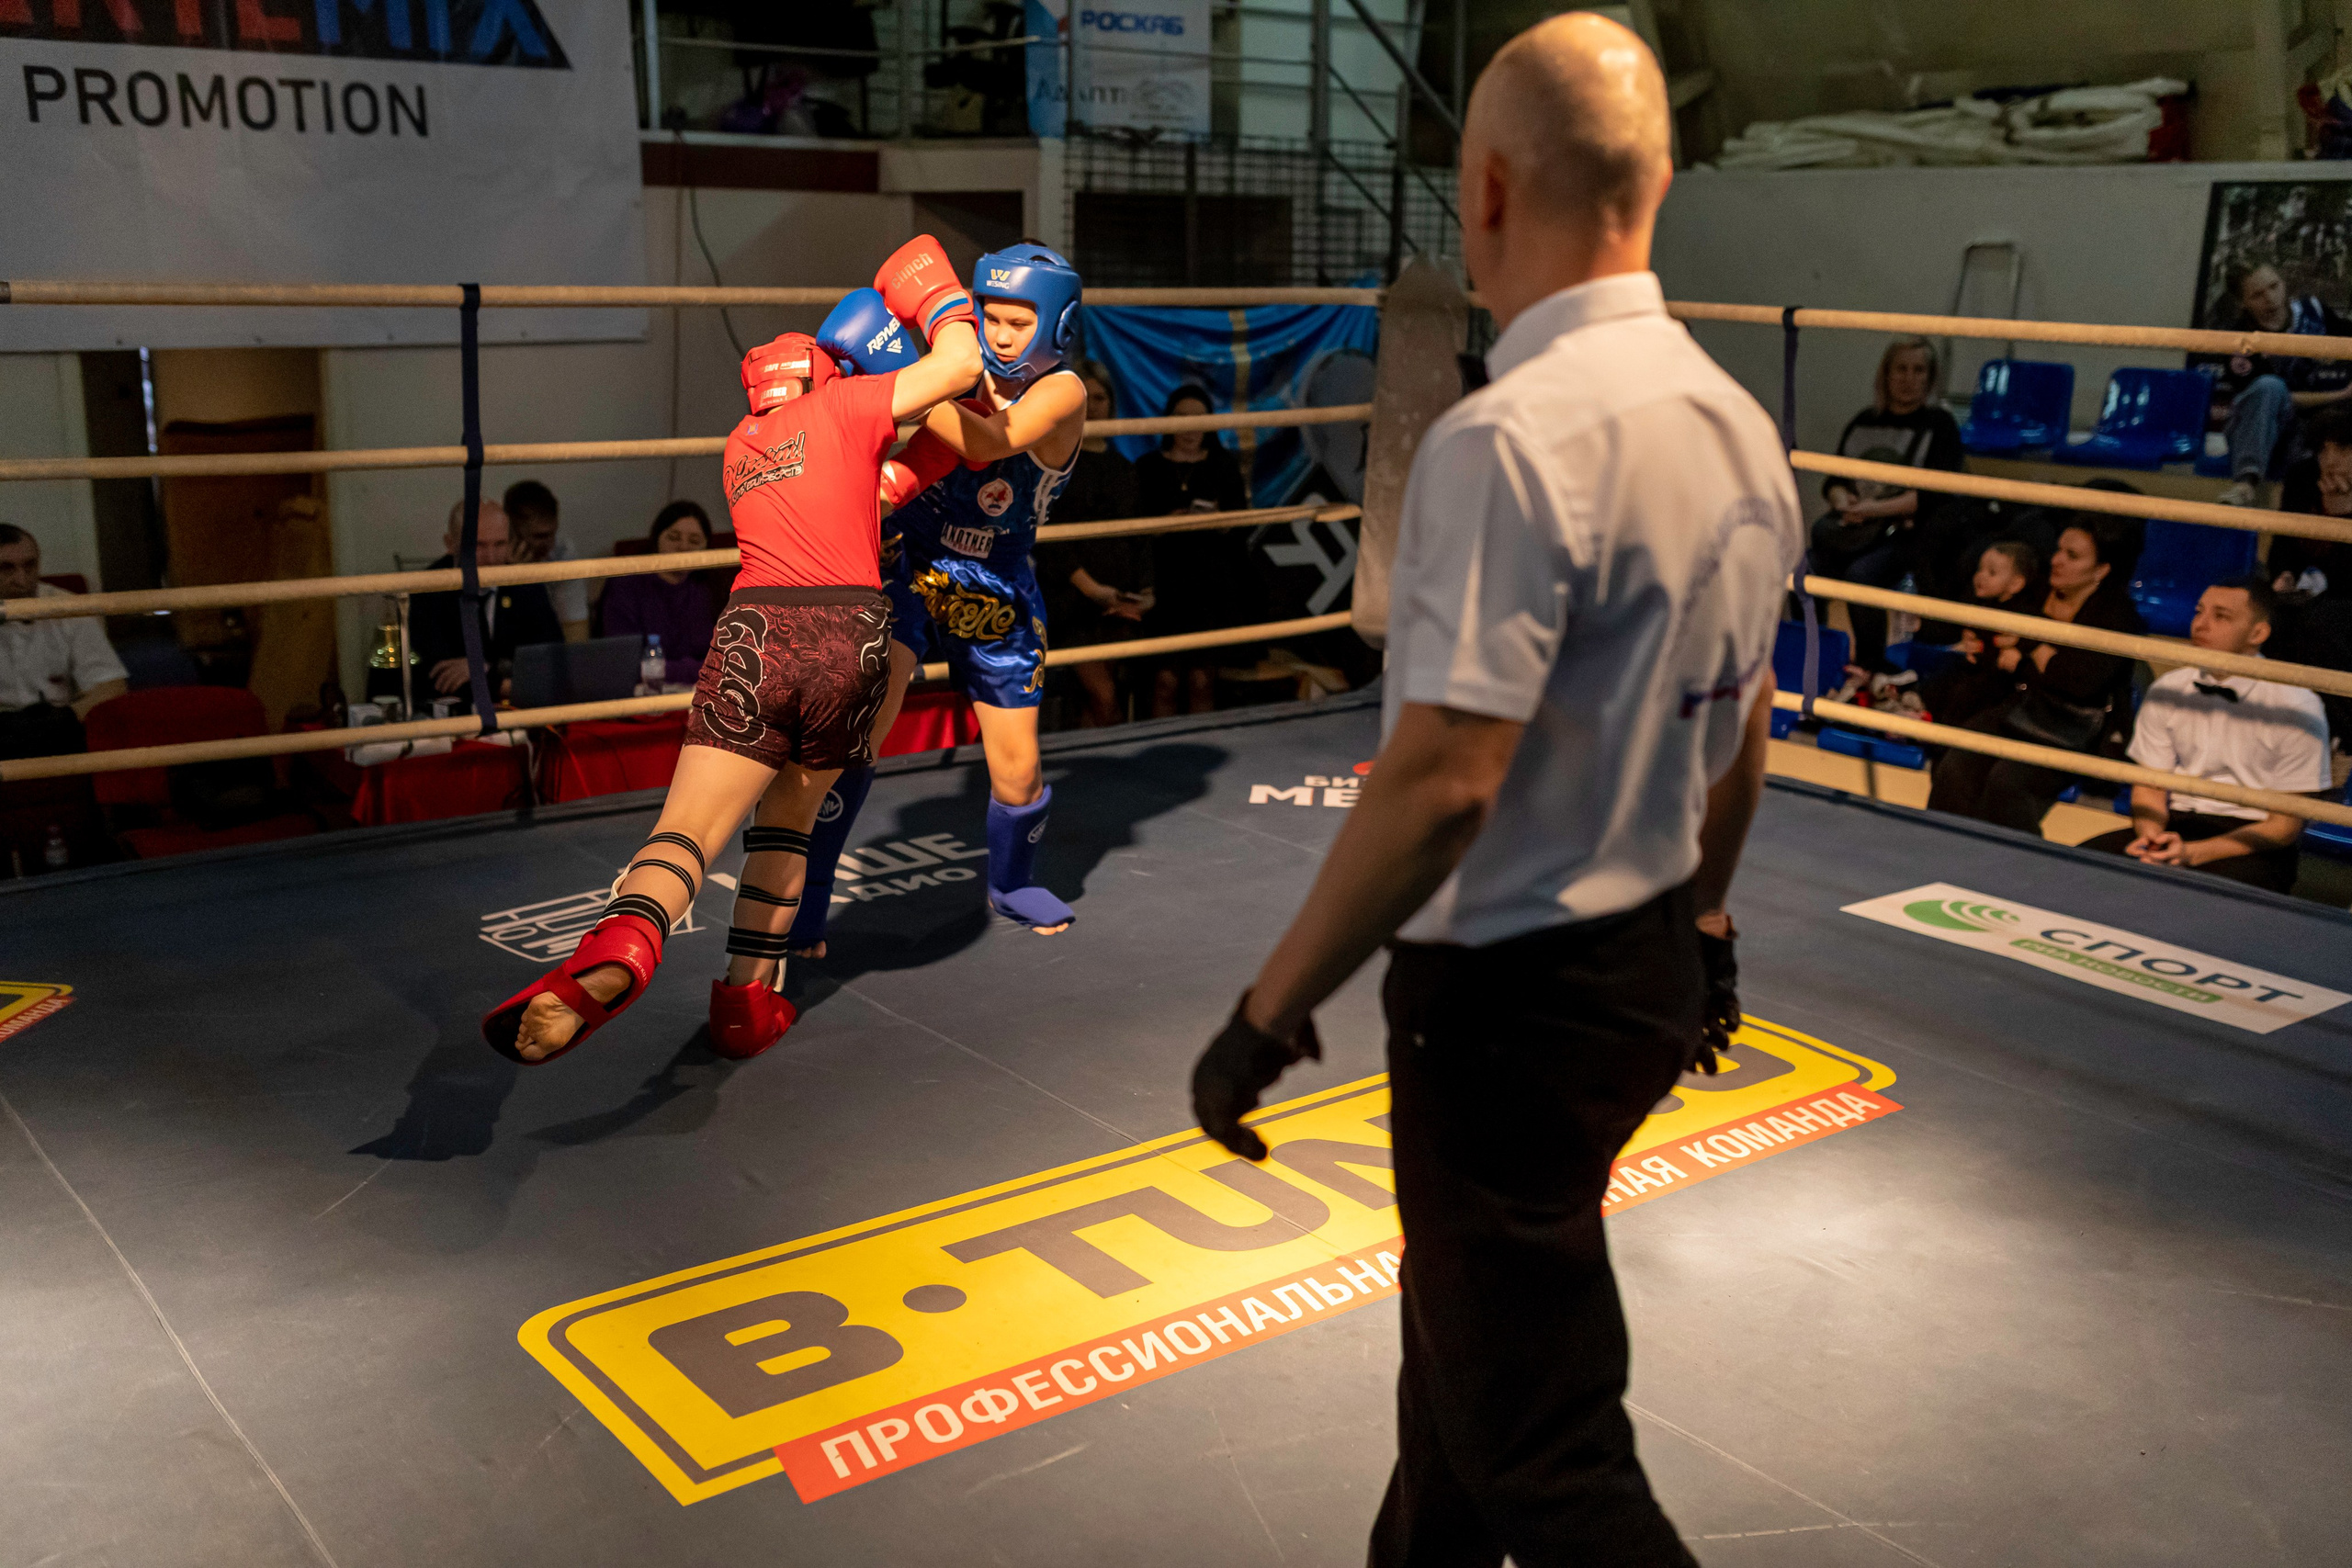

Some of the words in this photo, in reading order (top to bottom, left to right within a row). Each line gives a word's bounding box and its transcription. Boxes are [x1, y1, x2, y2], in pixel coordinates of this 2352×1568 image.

[23, 64, 429, 137] PROMOTION
[891, 252, 933, 289] clinch
[2041, 930, 2303, 1002] СПОРТ
[820, 1246, 1406, 1480] ПРОФЕССИОНАЛЬНА
[1679, 1091, 1881, 1168] КОМАНДА
